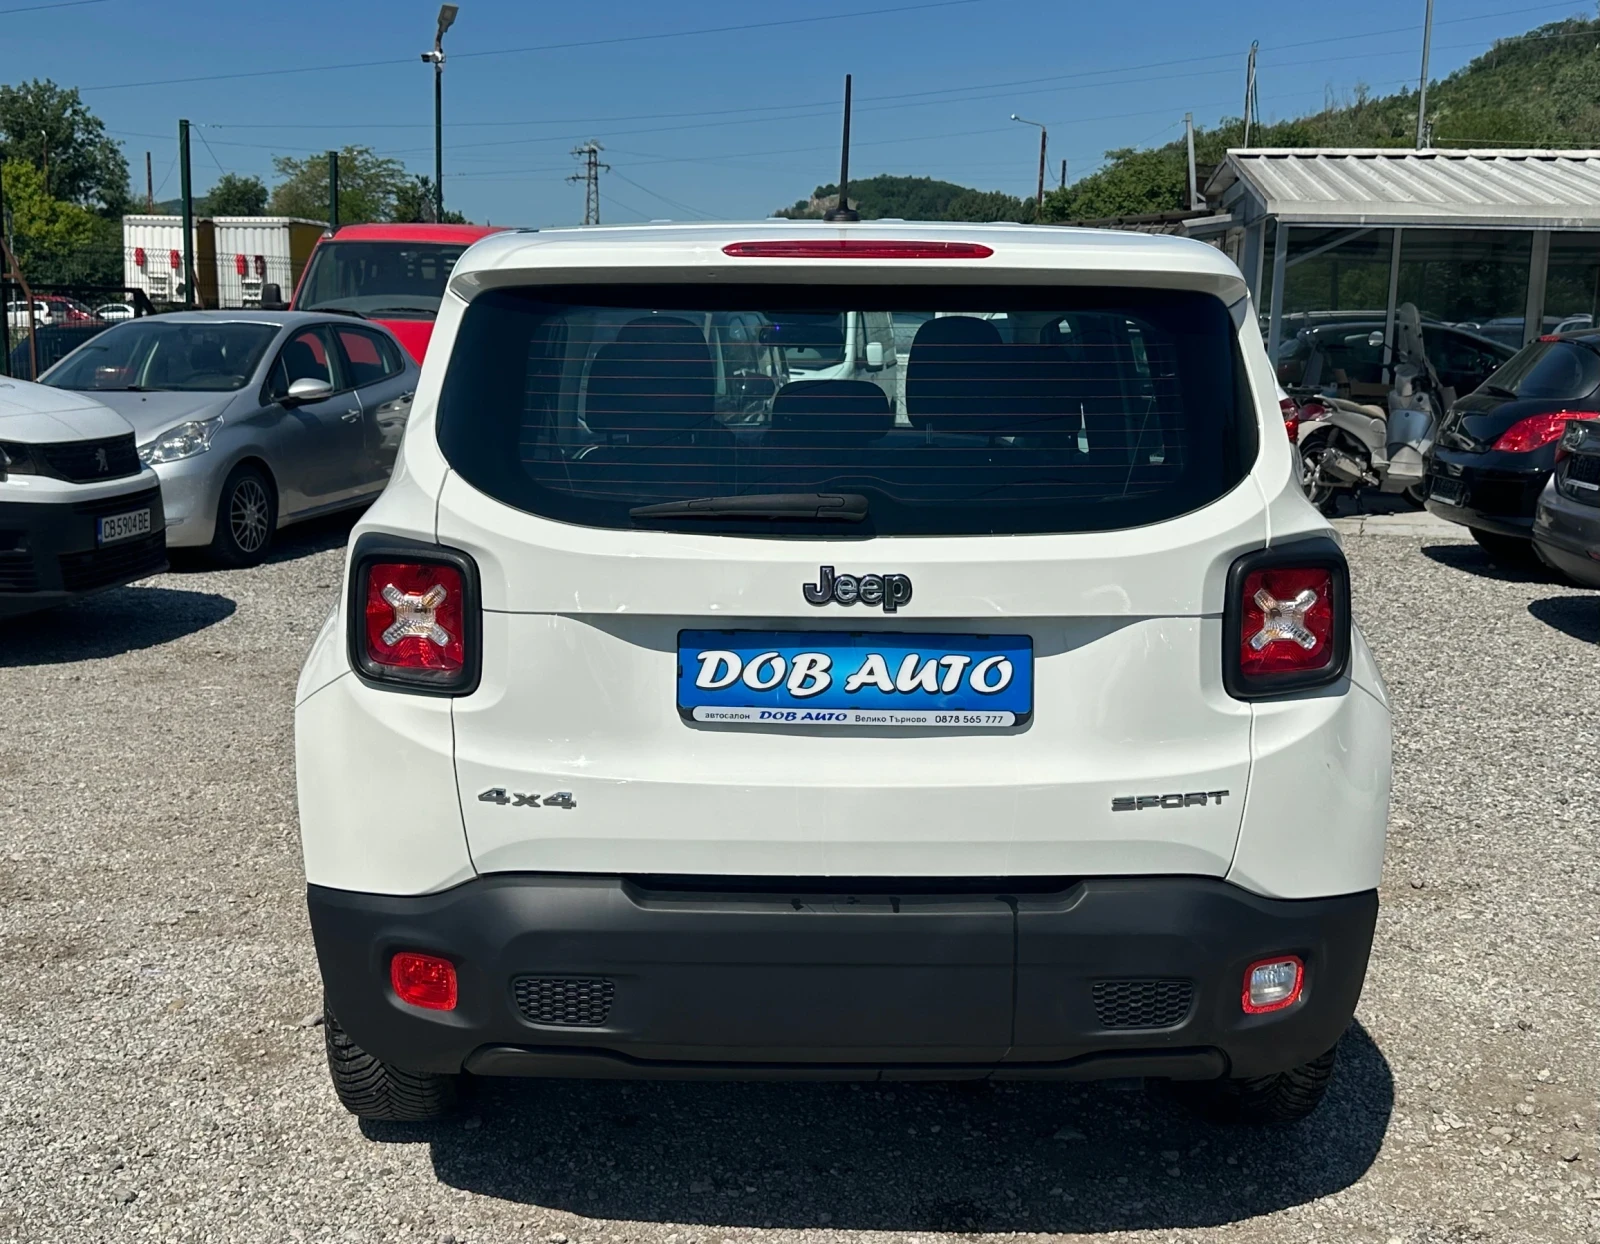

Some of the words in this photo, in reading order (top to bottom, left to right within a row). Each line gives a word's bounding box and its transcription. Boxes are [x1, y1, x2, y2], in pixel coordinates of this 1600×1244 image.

[803, 565, 913, 613] Jeep
[695, 649, 833, 697] DOB
[844, 652, 1014, 694] AUTO
[704, 711, 751, 720] автосалон
[759, 710, 798, 722] DOB
[801, 711, 848, 722] AUTO
[855, 714, 887, 723] Велико
[889, 715, 927, 725] Търново
[934, 715, 960, 724] 0878
[963, 715, 982, 724] 565
[985, 715, 1004, 724] 777
[477, 787, 577, 810] 4x4
[1111, 789, 1230, 812] SPORT
